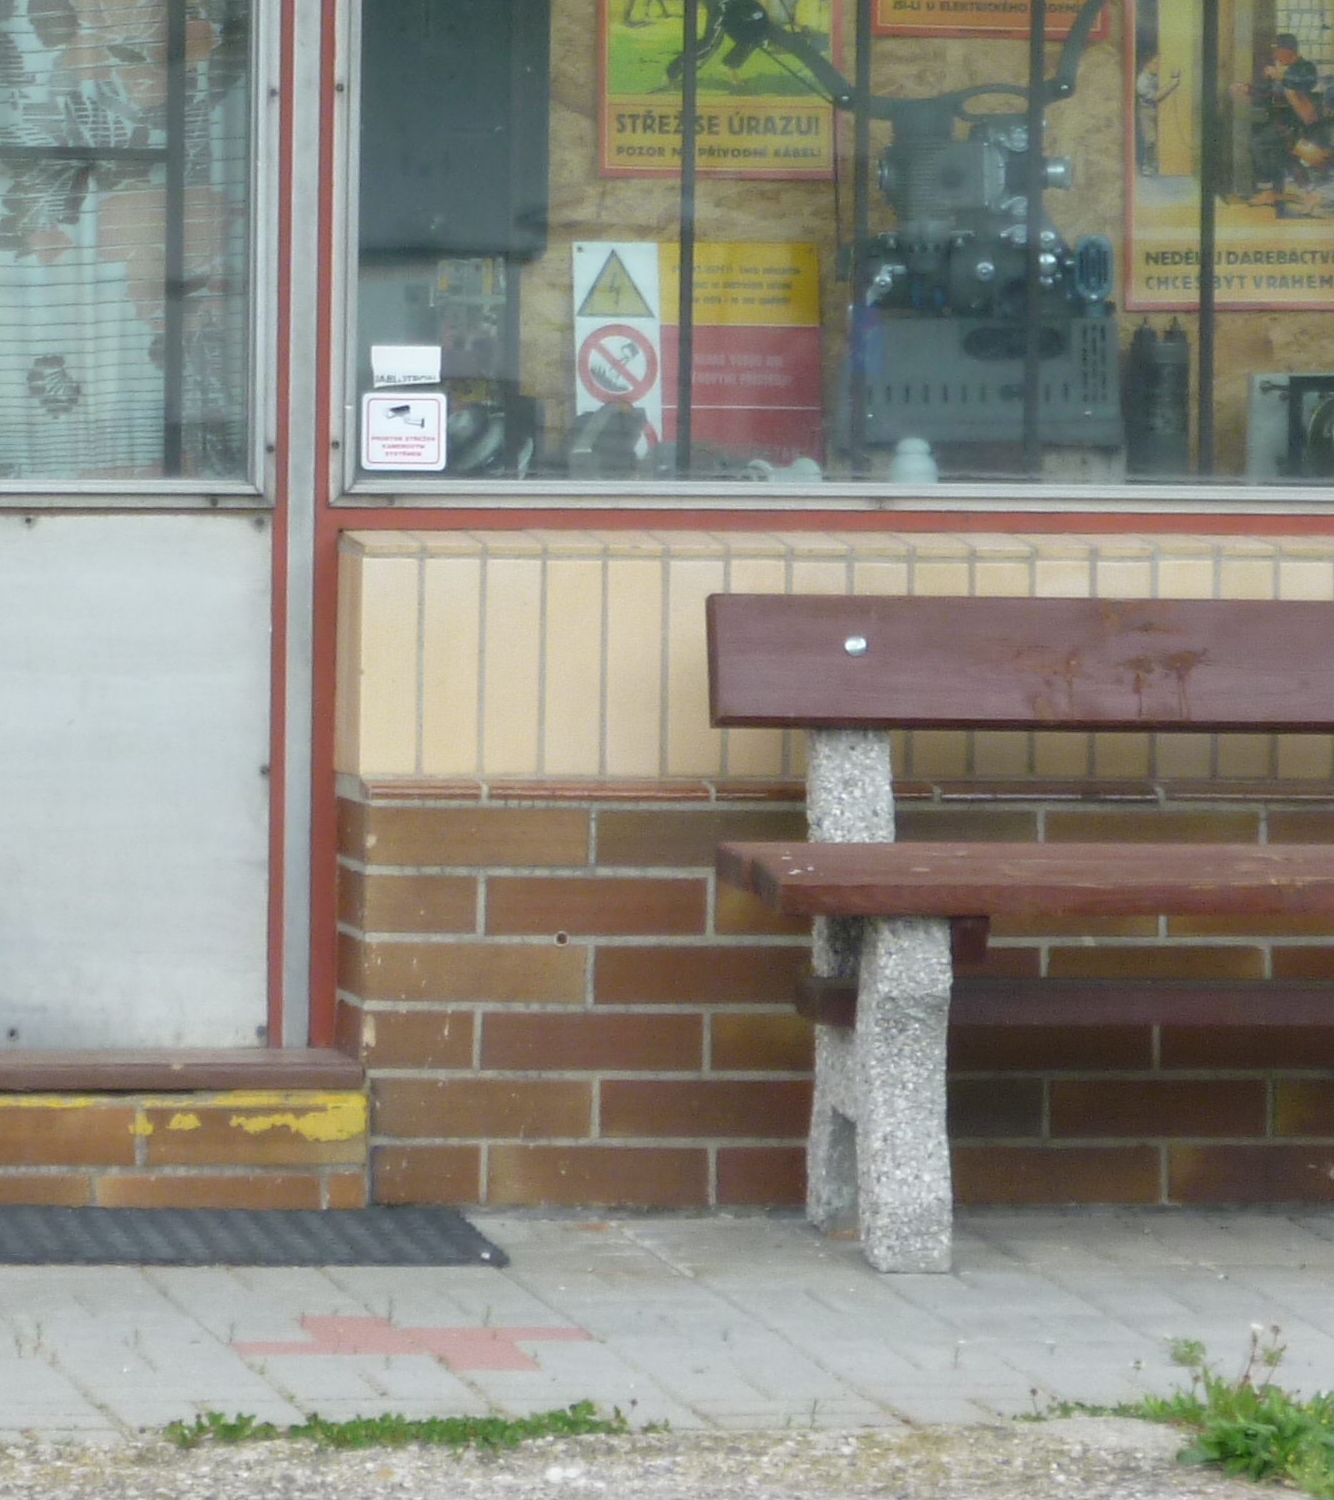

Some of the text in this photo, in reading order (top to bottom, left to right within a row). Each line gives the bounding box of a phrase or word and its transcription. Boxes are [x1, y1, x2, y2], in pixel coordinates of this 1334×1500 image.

[694, 114, 721, 136] SE
[728, 111, 821, 136] ÚRAZU!
[616, 146, 666, 158] POZOR
